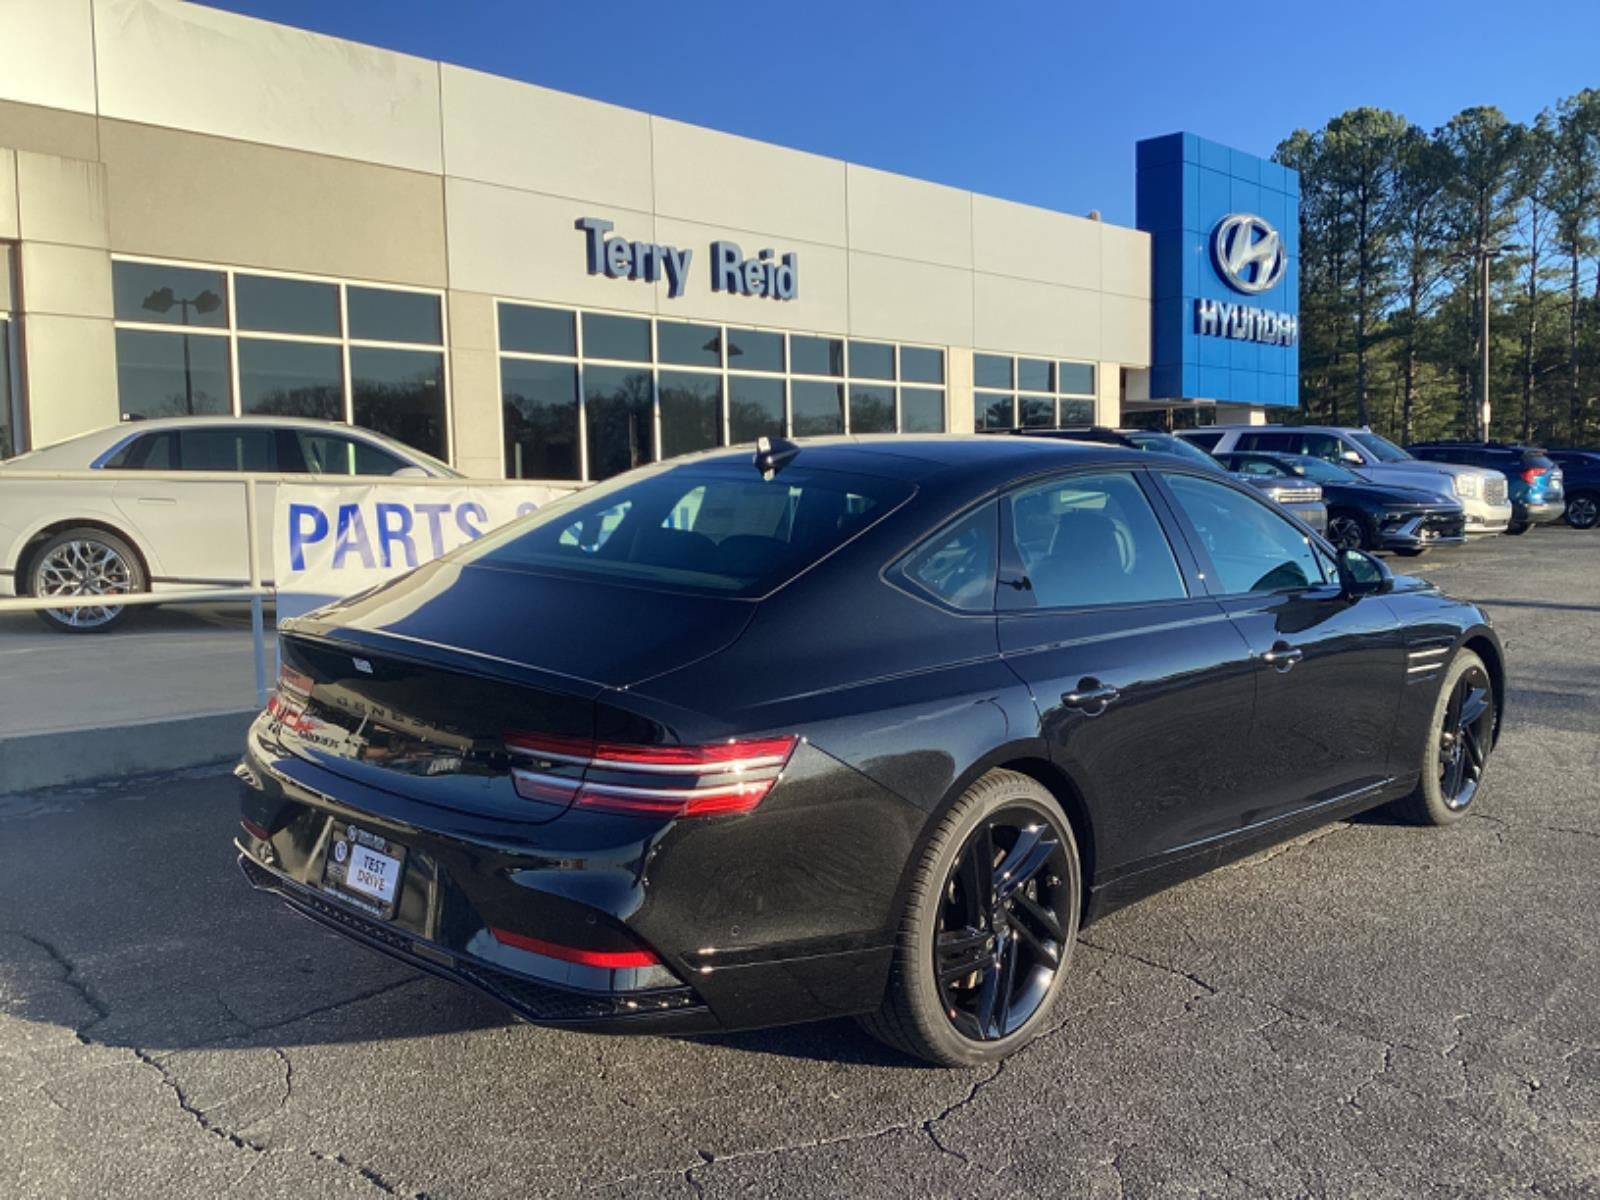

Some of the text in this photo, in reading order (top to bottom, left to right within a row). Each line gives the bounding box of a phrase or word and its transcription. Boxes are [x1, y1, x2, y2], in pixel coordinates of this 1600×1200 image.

[574, 217, 799, 302] Terry Reid
[1194, 298, 1298, 347] HYUNDAI
[288, 501, 489, 572] PARTS
[356, 868, 385, 891] DRIVE
[363, 855, 387, 875] TEST
